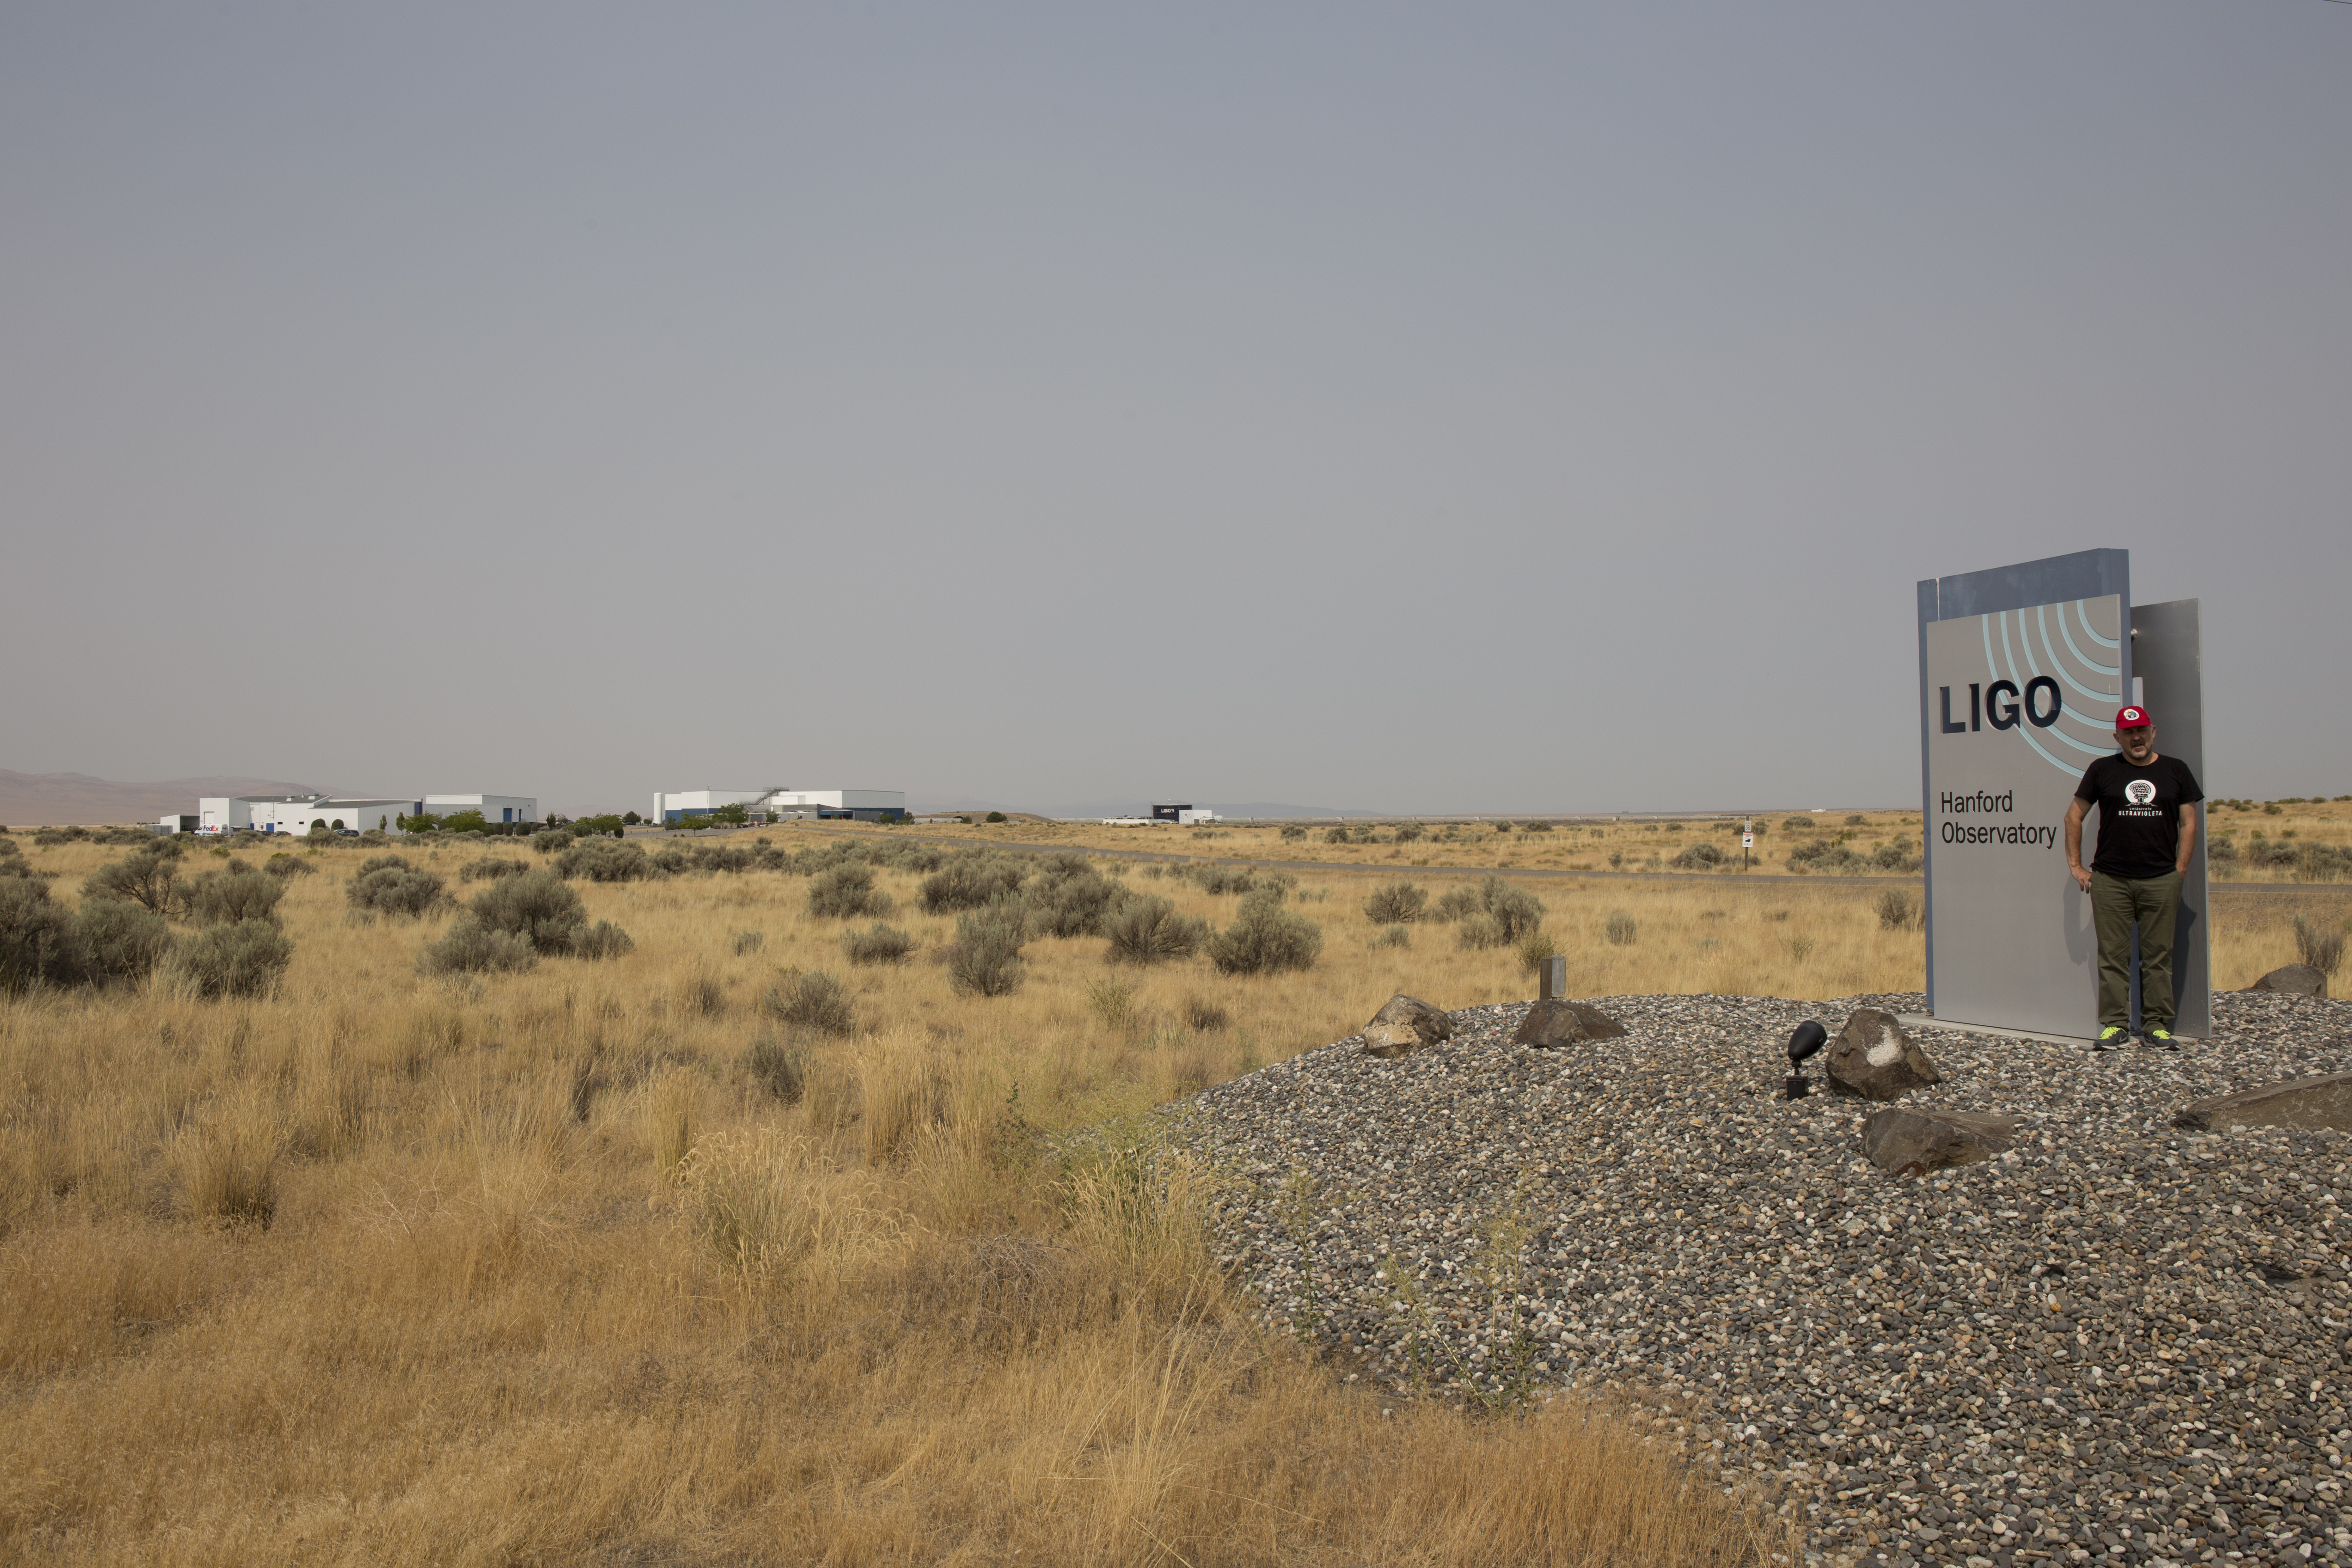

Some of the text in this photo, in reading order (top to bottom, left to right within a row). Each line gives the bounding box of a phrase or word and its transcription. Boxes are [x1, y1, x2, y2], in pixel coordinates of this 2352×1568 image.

[1939, 676, 2062, 734] LIGO
[1941, 790, 2013, 813] Hanford
[1942, 821, 2057, 850] Observatory
